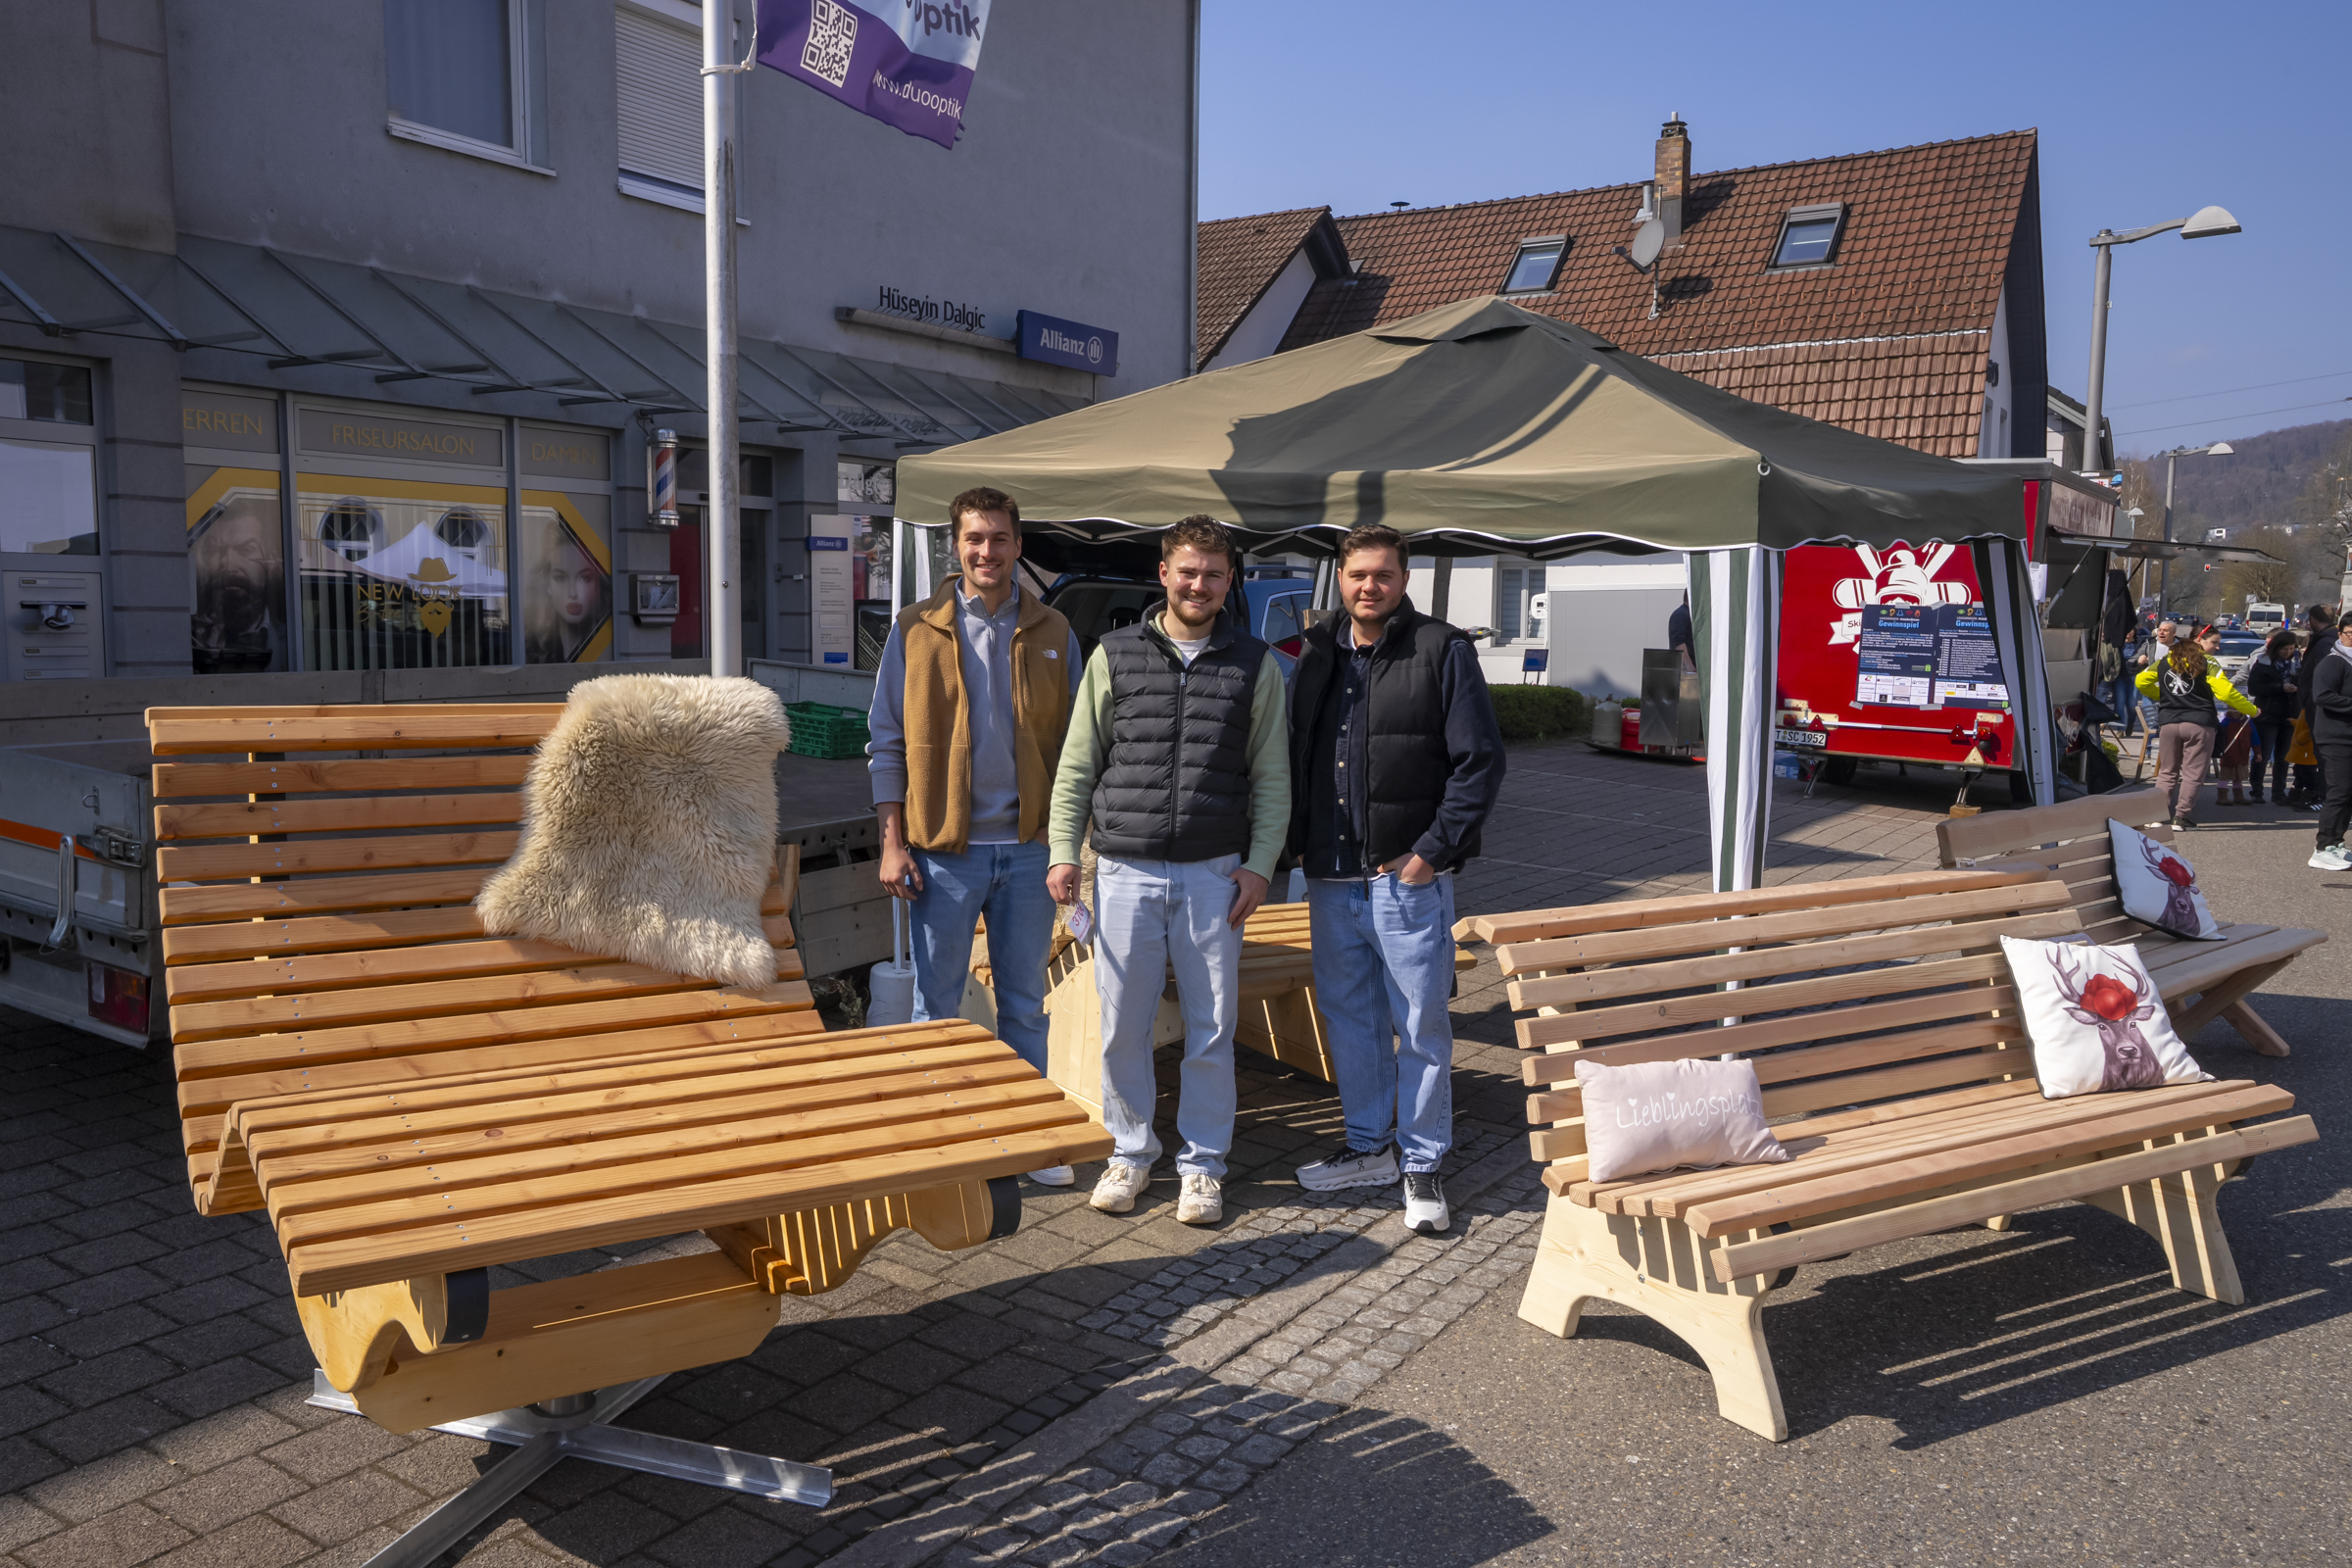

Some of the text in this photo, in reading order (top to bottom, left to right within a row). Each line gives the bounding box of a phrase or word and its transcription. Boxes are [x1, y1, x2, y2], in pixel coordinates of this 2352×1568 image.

[880, 285, 986, 332] Hüseyin Dalgic
[1040, 327, 1085, 356] Allianz
[332, 424, 474, 456] FRISEURSALON
[532, 443, 596, 465] DAMEN
[357, 583, 464, 601] NEW LOOK
[1879, 619, 1920, 629] Gewinnspiel
[1788, 731, 1799, 742] SC
[1801, 733, 1825, 745] 1952
[1616, 1089, 1763, 1128] Lieblingsplatz
